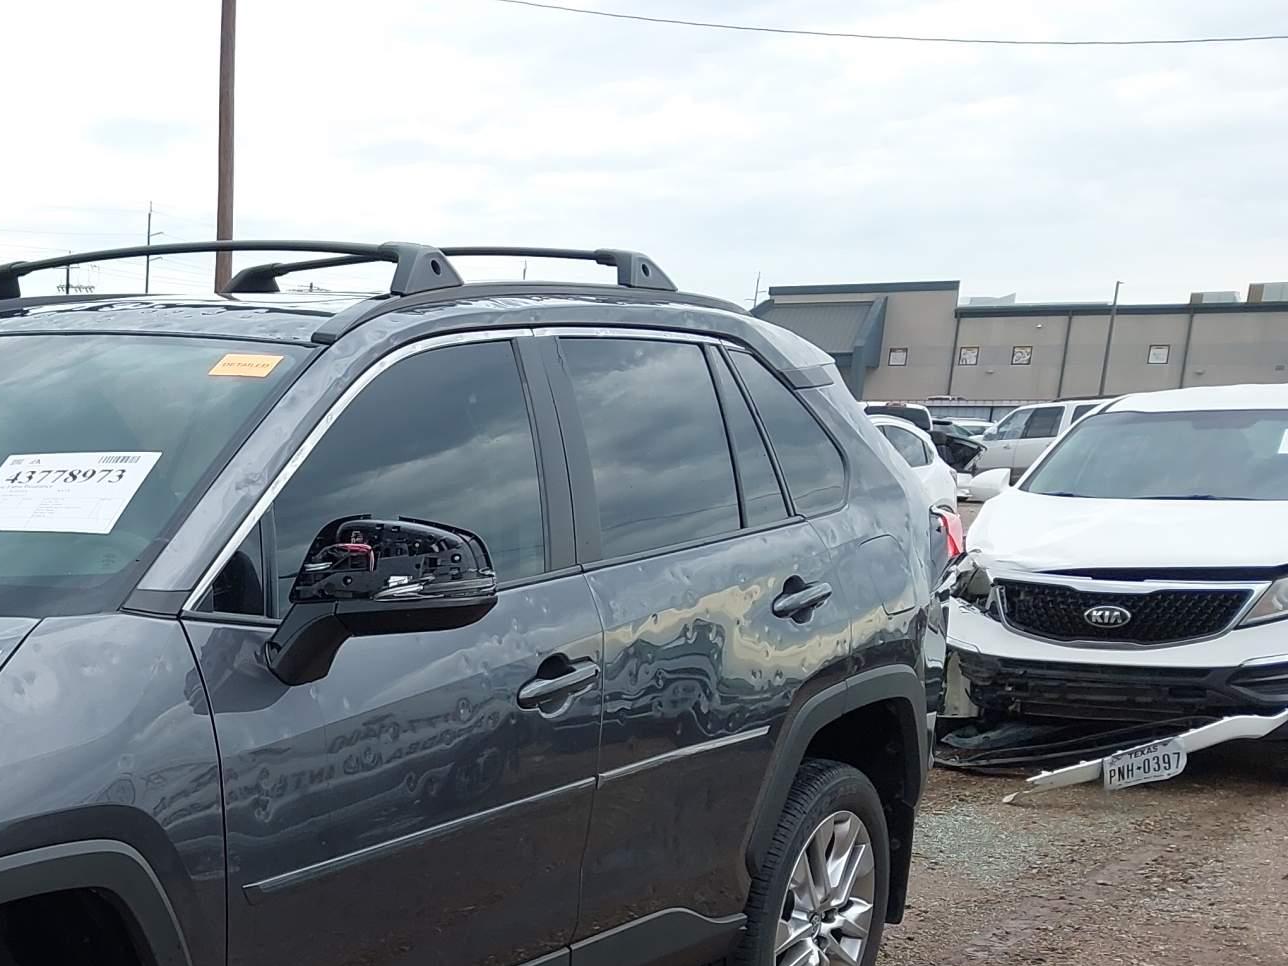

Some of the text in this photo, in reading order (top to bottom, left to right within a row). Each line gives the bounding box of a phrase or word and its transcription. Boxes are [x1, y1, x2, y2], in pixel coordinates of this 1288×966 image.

[5, 468, 127, 484] 43778973
[1092, 610, 1122, 624] KIA
[1128, 745, 1159, 760] TEXAS
